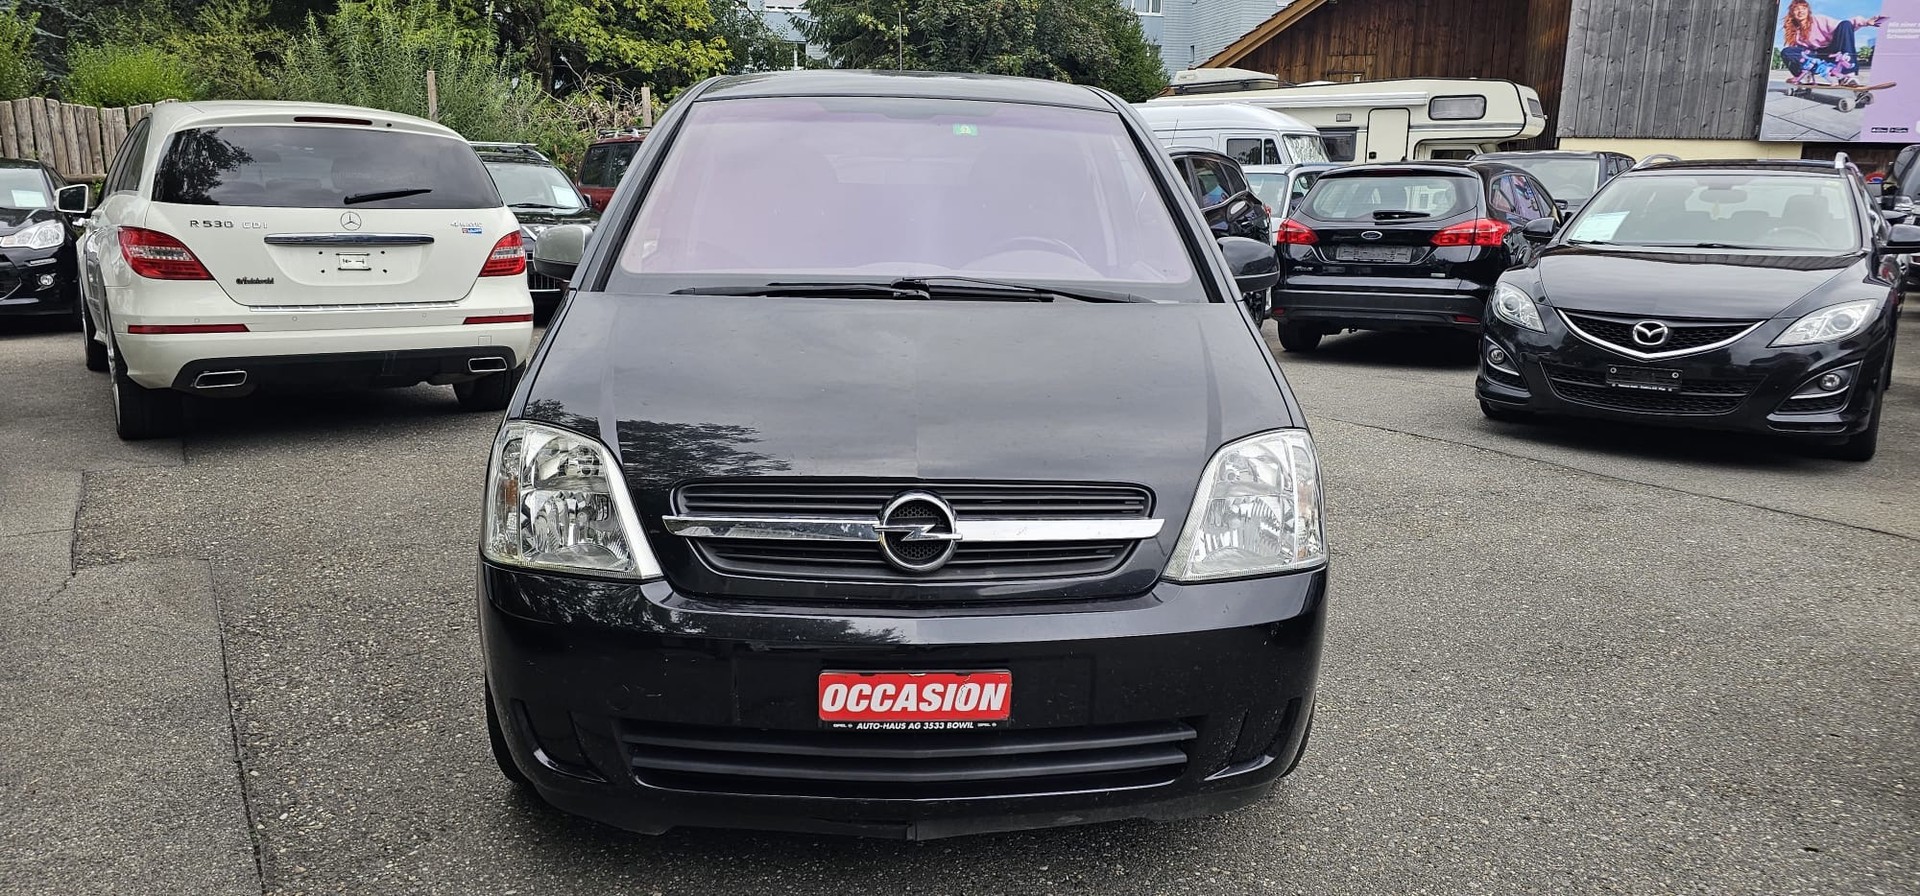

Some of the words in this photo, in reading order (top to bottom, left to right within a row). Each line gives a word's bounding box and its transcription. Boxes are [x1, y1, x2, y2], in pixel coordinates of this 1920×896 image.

[190, 220, 200, 228] R
[242, 221, 268, 230] CDI
[821, 682, 1008, 712] OCCASION
[856, 722, 907, 730] AUTO-HAUS
[907, 722, 922, 730] AG
[923, 721, 945, 730] 3533
[946, 721, 974, 729] BOWIL
